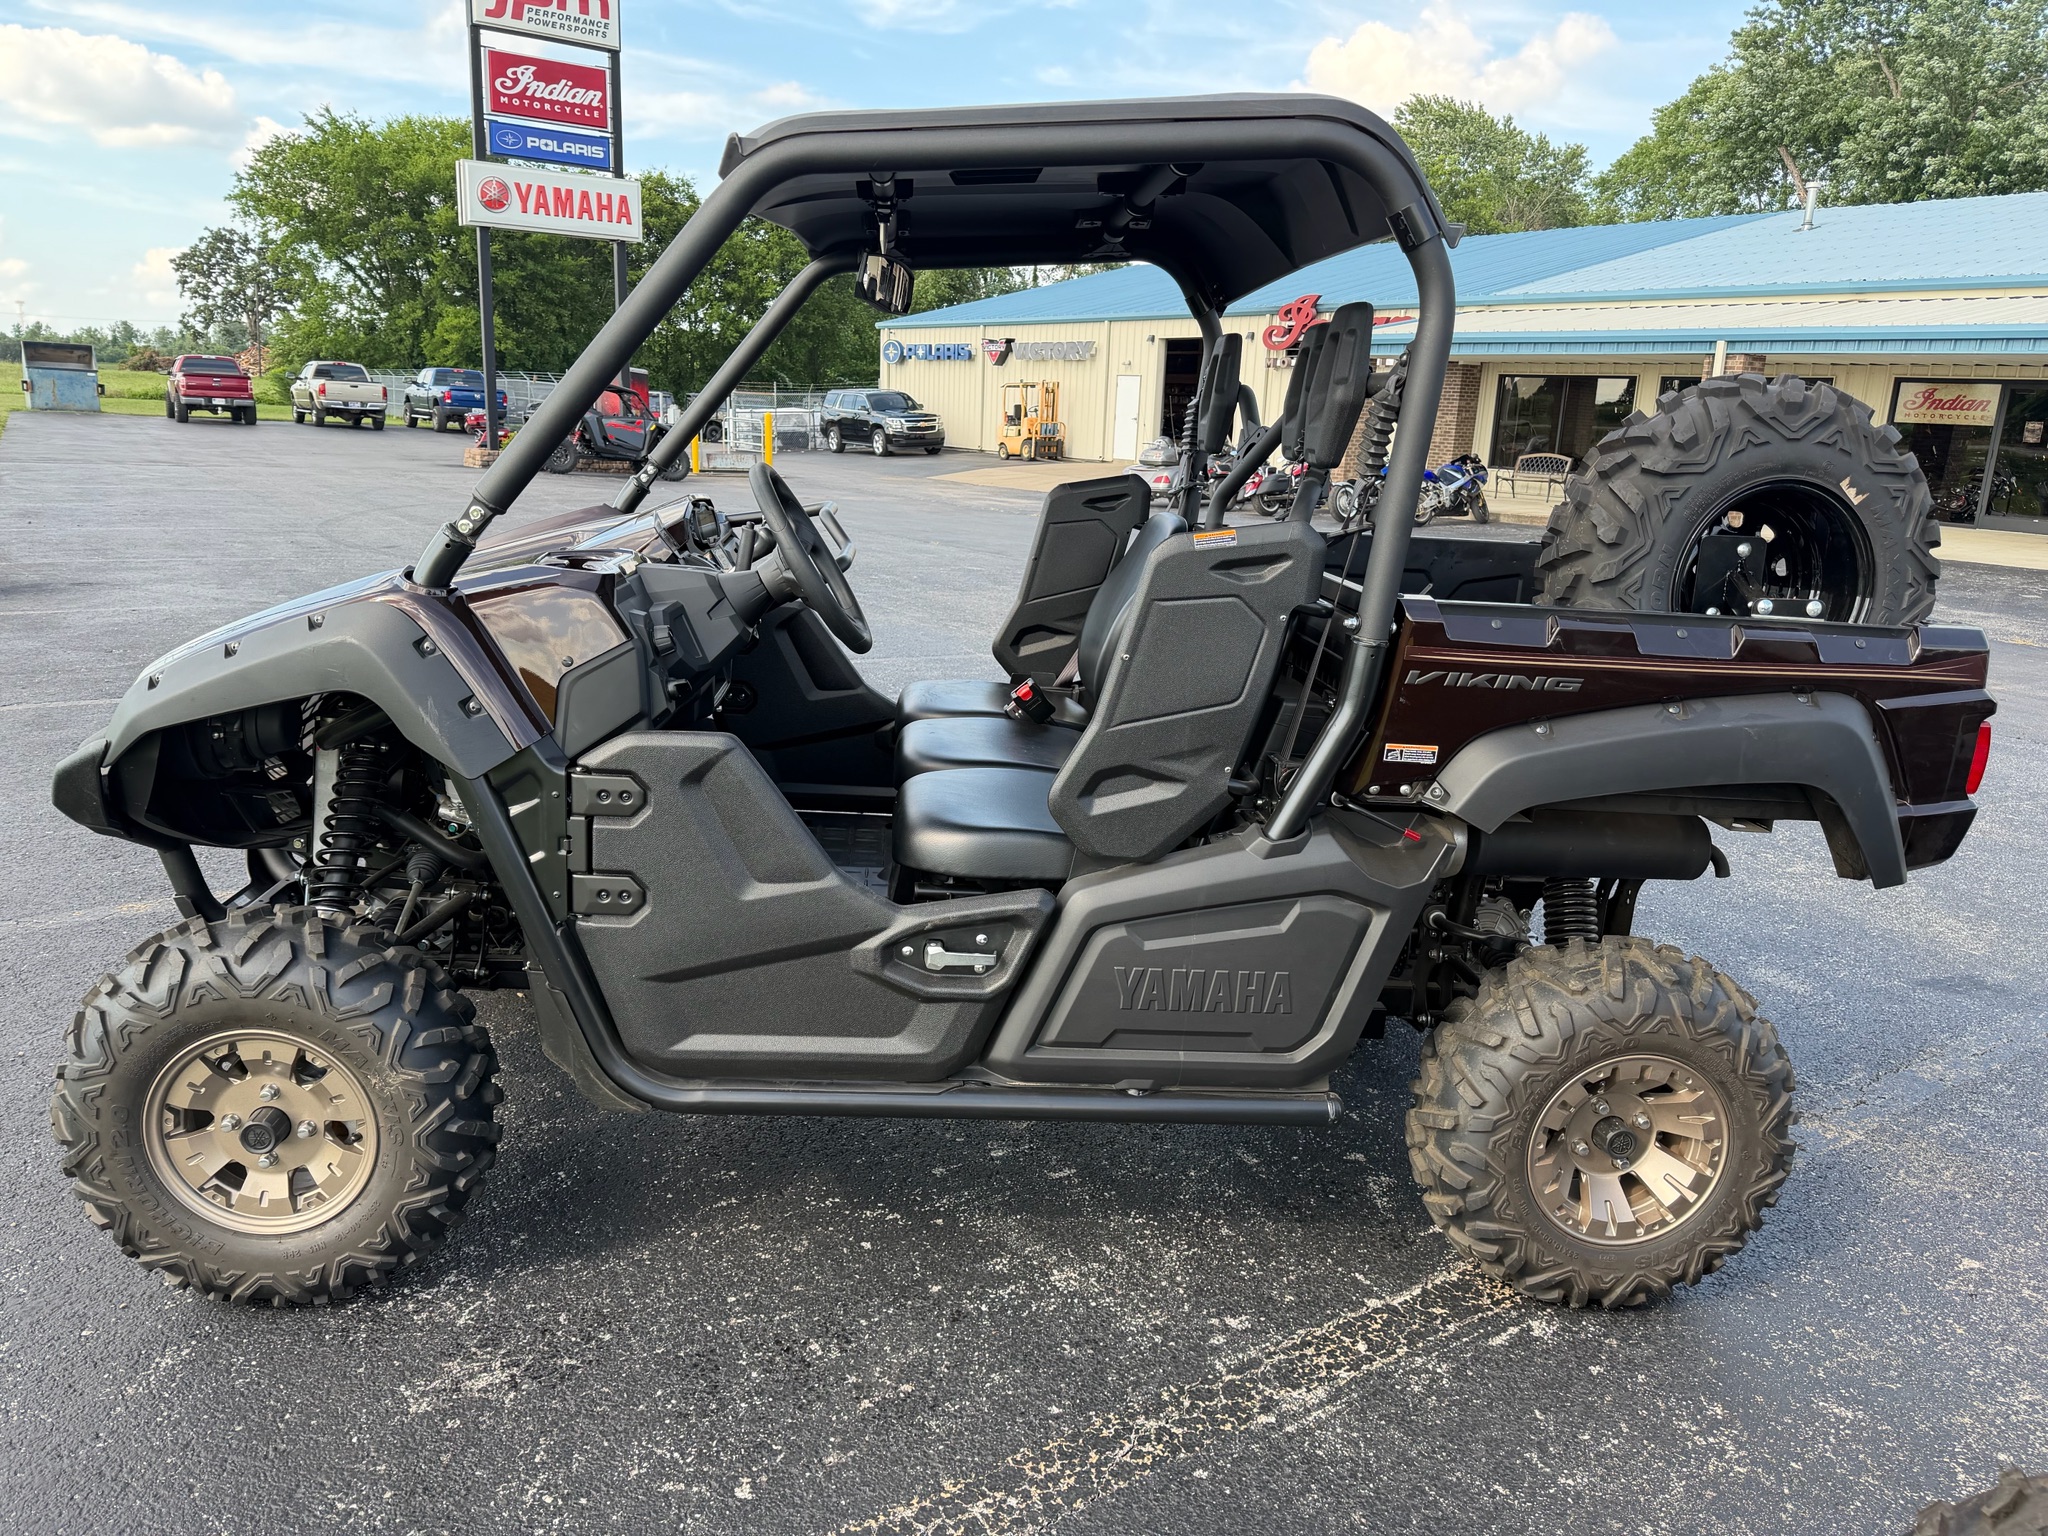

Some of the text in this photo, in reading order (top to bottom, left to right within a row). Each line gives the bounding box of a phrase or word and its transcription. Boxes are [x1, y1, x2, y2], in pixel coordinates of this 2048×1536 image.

[526, 17, 608, 39] POWERSPORTS
[527, 7, 610, 30] PERFORMANCE
[494, 65, 603, 108] Indian
[500, 96, 600, 118] MOTORCYCLE
[527, 136, 605, 159] POLARIS
[514, 182, 632, 225] YAMAHA
[906, 343, 973, 361] POLARIS
[1011, 340, 1096, 361] VICTORY
[1903, 388, 1992, 412] Indian
[1904, 412, 1987, 421] MOTORCYCLE
[1404, 669, 1584, 692] VIKING
[1114, 966, 1292, 1014] YAMAHA
[114, 1155, 226, 1256] BIGHORN
